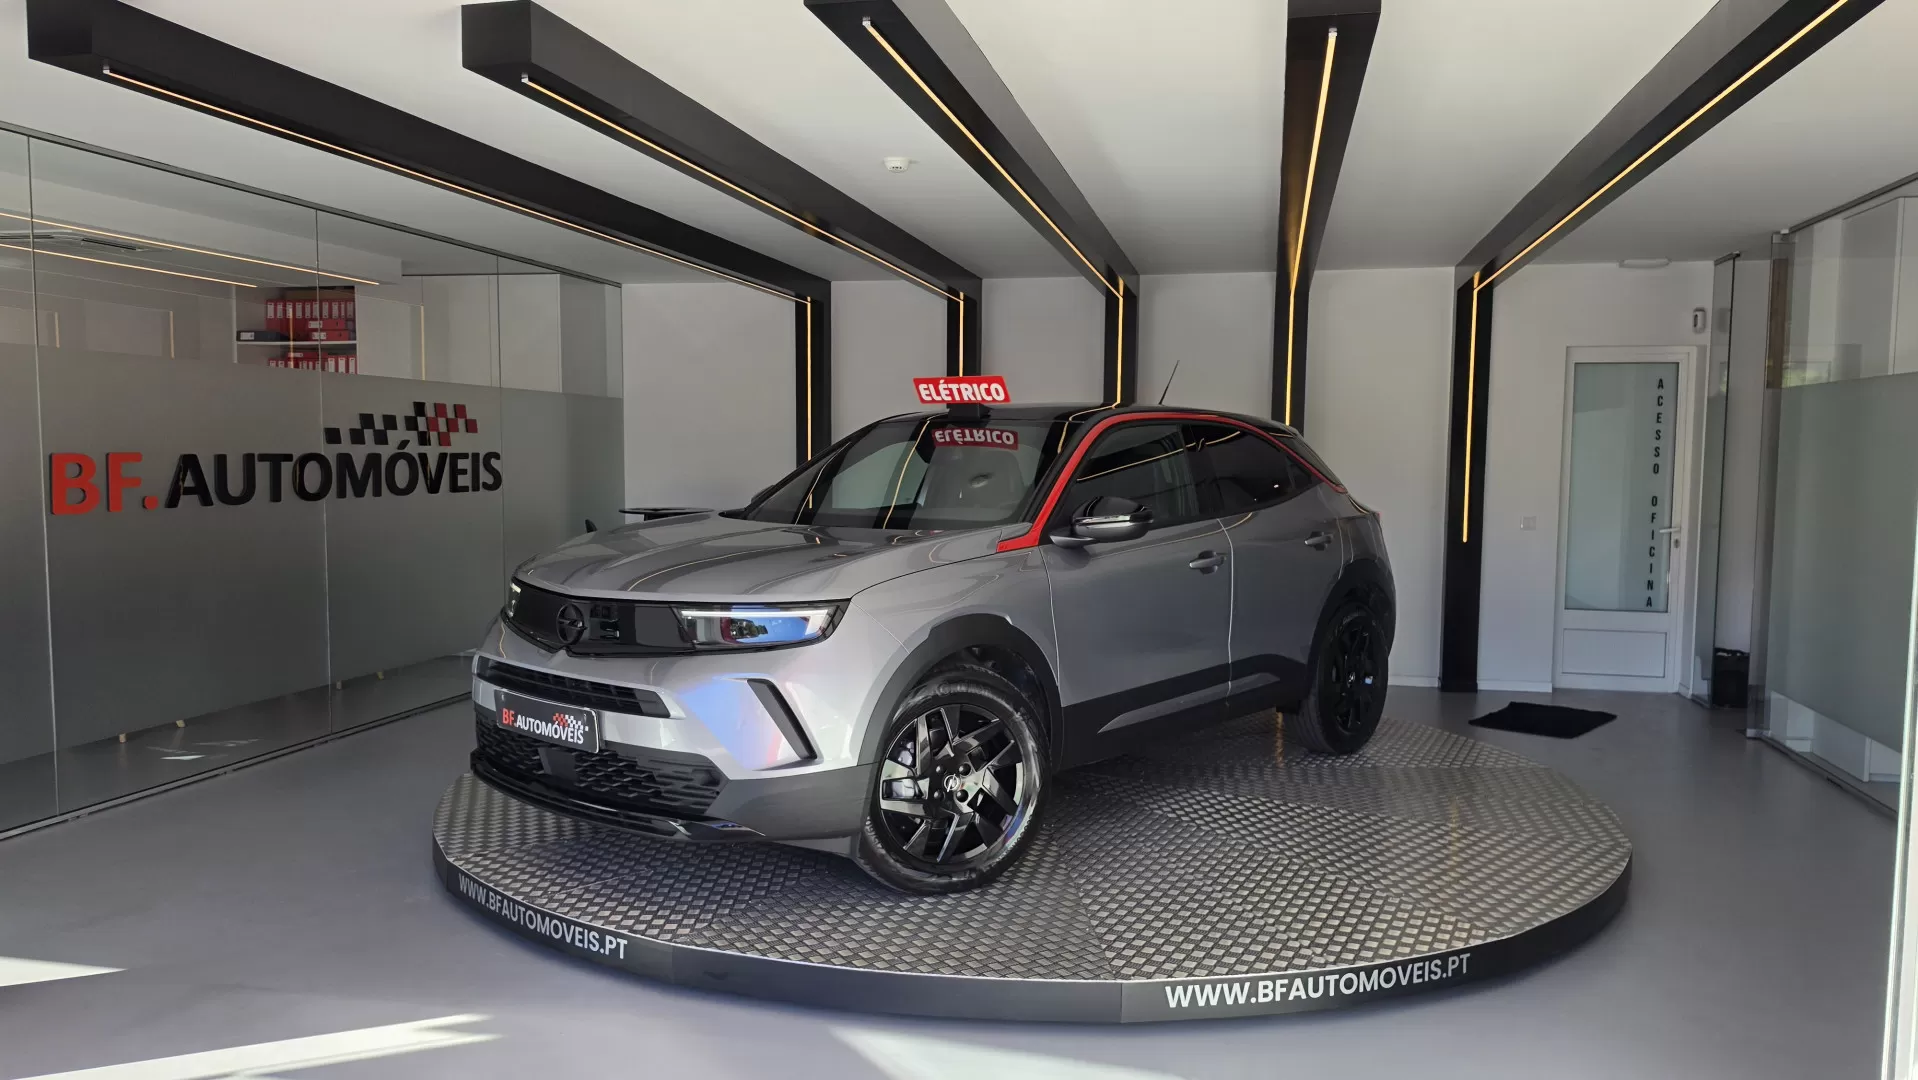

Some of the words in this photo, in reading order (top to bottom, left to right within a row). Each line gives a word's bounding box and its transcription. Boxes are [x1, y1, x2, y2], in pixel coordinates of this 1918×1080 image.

[918, 379, 1005, 401] ELÉTRICO
[1652, 378, 1664, 475] ACESSO
[1646, 496, 1658, 608] OFICINA
[458, 873, 628, 960] WWW.BFAUTOMOVEIS.PT
[1165, 952, 1471, 1009] WWW.BFAUTOMOVEIS.PT
